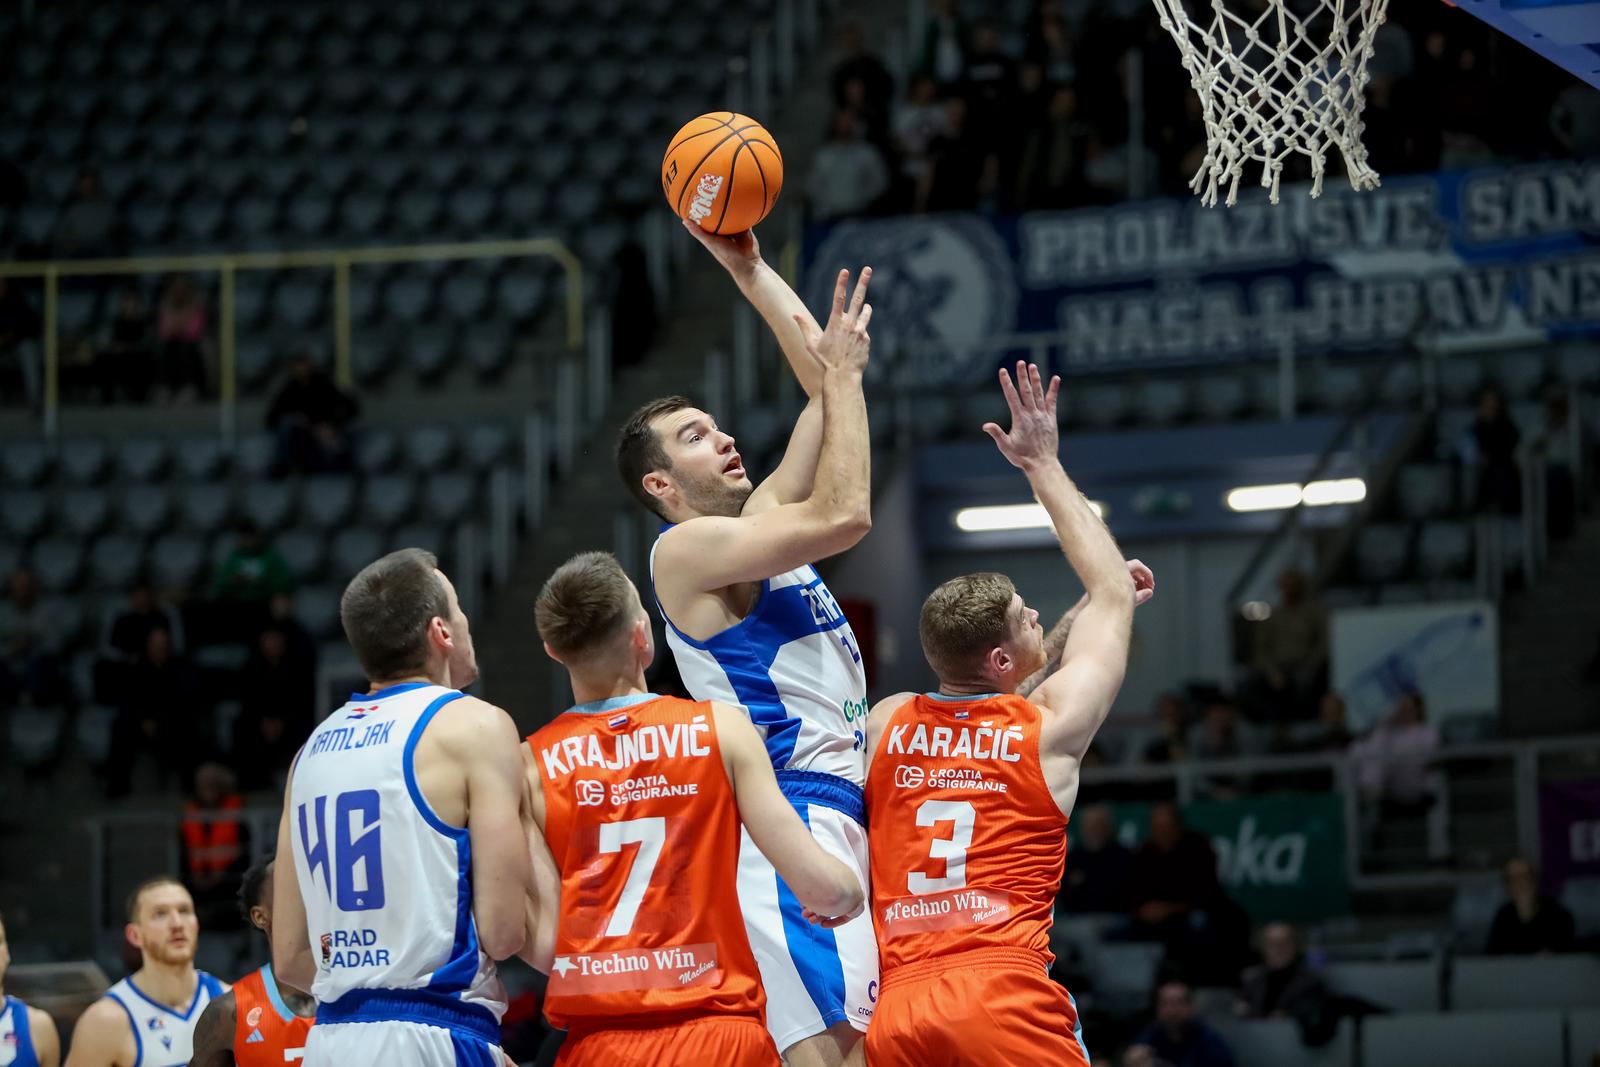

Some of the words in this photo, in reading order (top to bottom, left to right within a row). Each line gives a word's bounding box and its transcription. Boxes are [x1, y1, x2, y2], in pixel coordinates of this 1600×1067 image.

[1030, 201, 1289, 279] PROLAZI
[542, 715, 711, 779] KRAJNOVIĆ
[887, 720, 1024, 763] KARAČIĆ
[610, 775, 668, 795] CROATIA
[927, 777, 1008, 793] OSIGURANJE
[929, 768, 983, 780] CROATIA
[610, 783, 698, 806] OSIGURANJE
[298, 789, 385, 912] 46
[907, 800, 977, 896] 3
[599, 817, 666, 937] 7
[893, 898, 950, 920] Techno
[953, 891, 989, 909] Win
[331, 929, 377, 948] RAD
[331, 949, 390, 968] ADAR
[577, 954, 649, 976] Techno
[653, 948, 696, 970] Win
[678, 961, 716, 984] Machine
